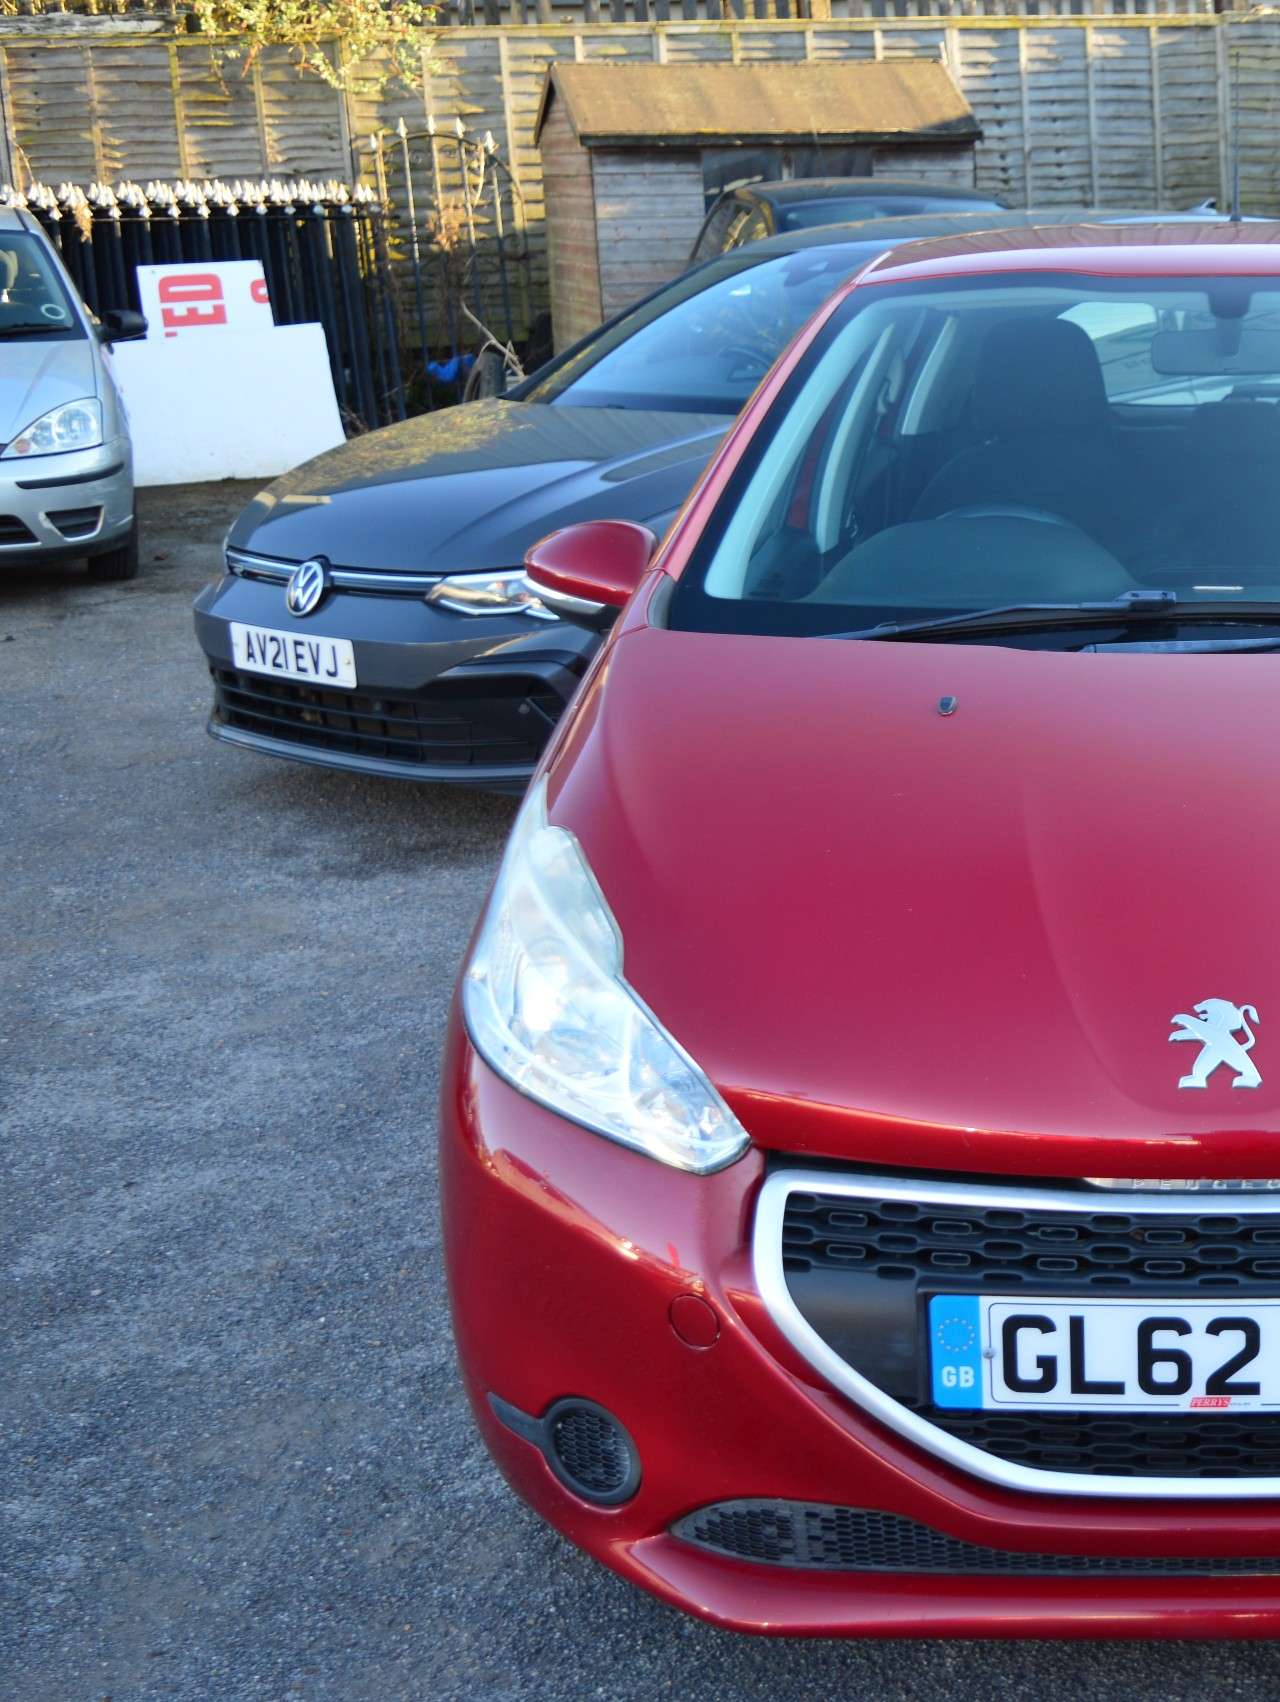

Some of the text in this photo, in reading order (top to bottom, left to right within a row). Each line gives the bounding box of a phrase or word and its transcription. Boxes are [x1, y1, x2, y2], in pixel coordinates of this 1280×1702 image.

[159, 273, 228, 338] ED
[942, 1365, 975, 1388] GB
[1001, 1313, 1262, 1396] GL62
